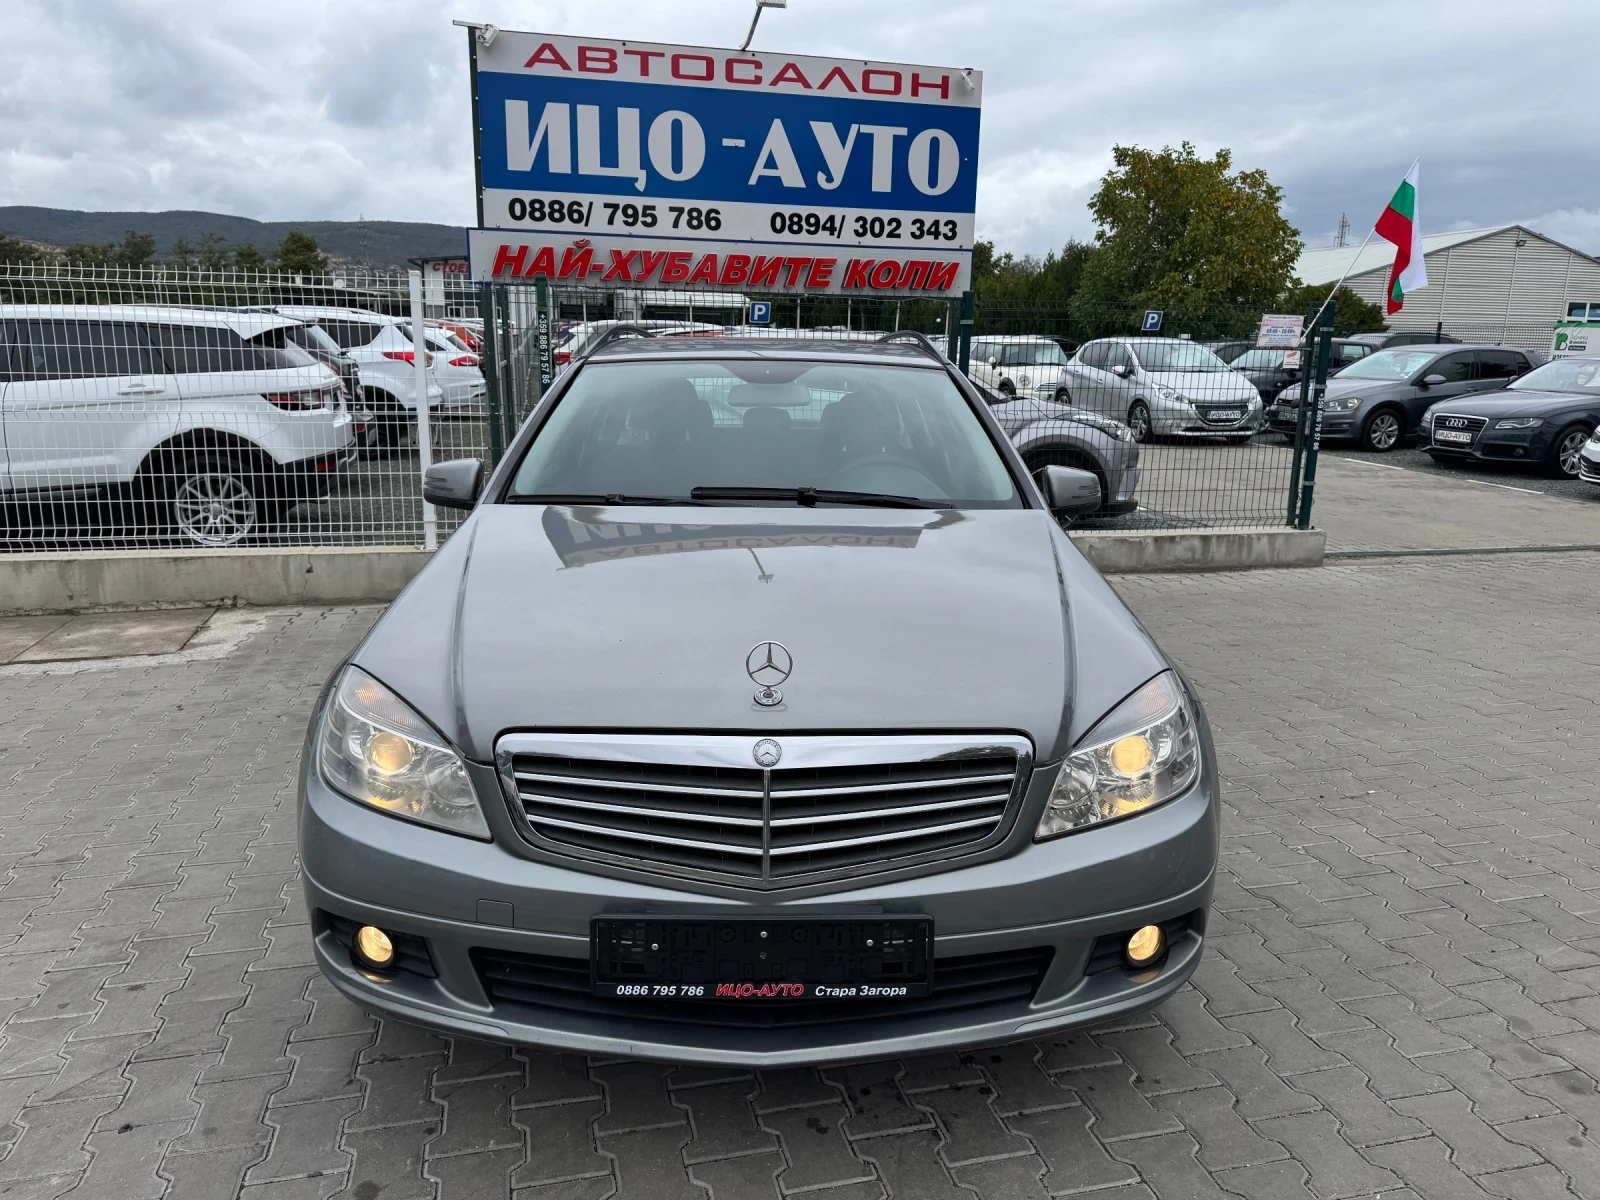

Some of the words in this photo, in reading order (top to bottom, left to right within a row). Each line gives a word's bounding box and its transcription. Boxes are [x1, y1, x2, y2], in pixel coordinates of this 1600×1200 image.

[523, 43, 950, 99] АВТОСАЛОН
[509, 198, 594, 227] 0886/
[603, 202, 658, 228] 795
[668, 206, 722, 231] 786
[770, 212, 846, 239] 0894/
[853, 216, 903, 239] 302
[910, 219, 958, 241] 343
[491, 239, 838, 289] НАЙ-ХУБАВИТЕ
[842, 258, 961, 291] КОЛИ
[754, 304, 766, 320] P
[539, 314, 547, 333] +359
[1146, 313, 1158, 328] P
[539, 336, 548, 349] 886
[541, 351, 549, 361] 79
[541, 364, 549, 372] 57
[542, 374, 550, 384] 86
[1438, 430, 1471, 441] ИЦО-АУТО
[616, 985, 650, 995] 0886
[652, 985, 677, 996] 795
[680, 985, 704, 996] 786
[715, 983, 805, 998] ИЦО-АУТО
[815, 985, 857, 998] Стара
[859, 985, 908, 998] Загора
